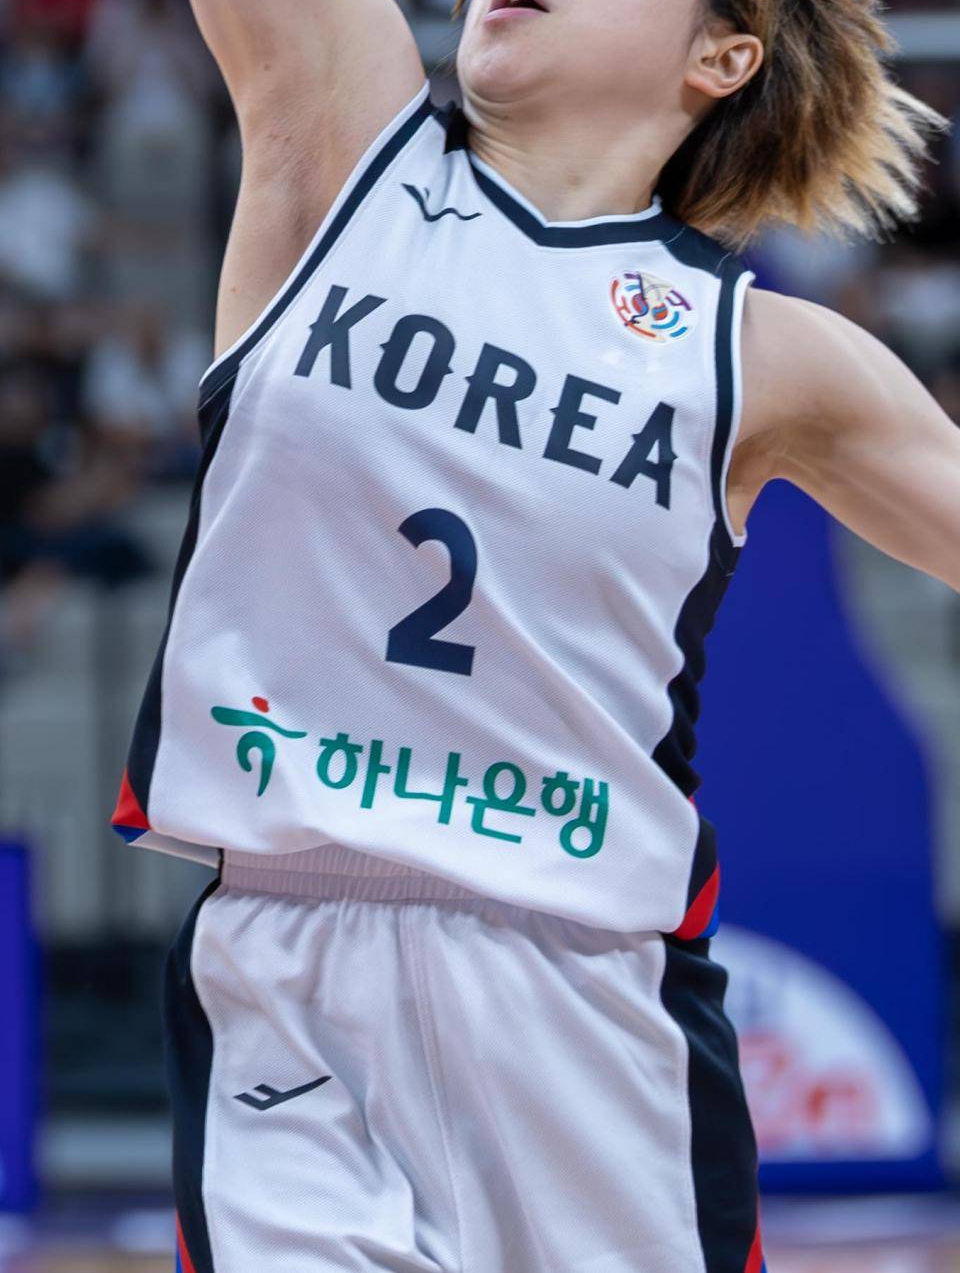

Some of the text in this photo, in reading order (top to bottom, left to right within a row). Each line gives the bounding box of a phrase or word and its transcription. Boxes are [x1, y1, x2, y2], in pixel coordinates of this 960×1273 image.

[293, 284, 680, 511] KOREA
[384, 507, 479, 677] 2
[316, 732, 609, 859] 하나은행
